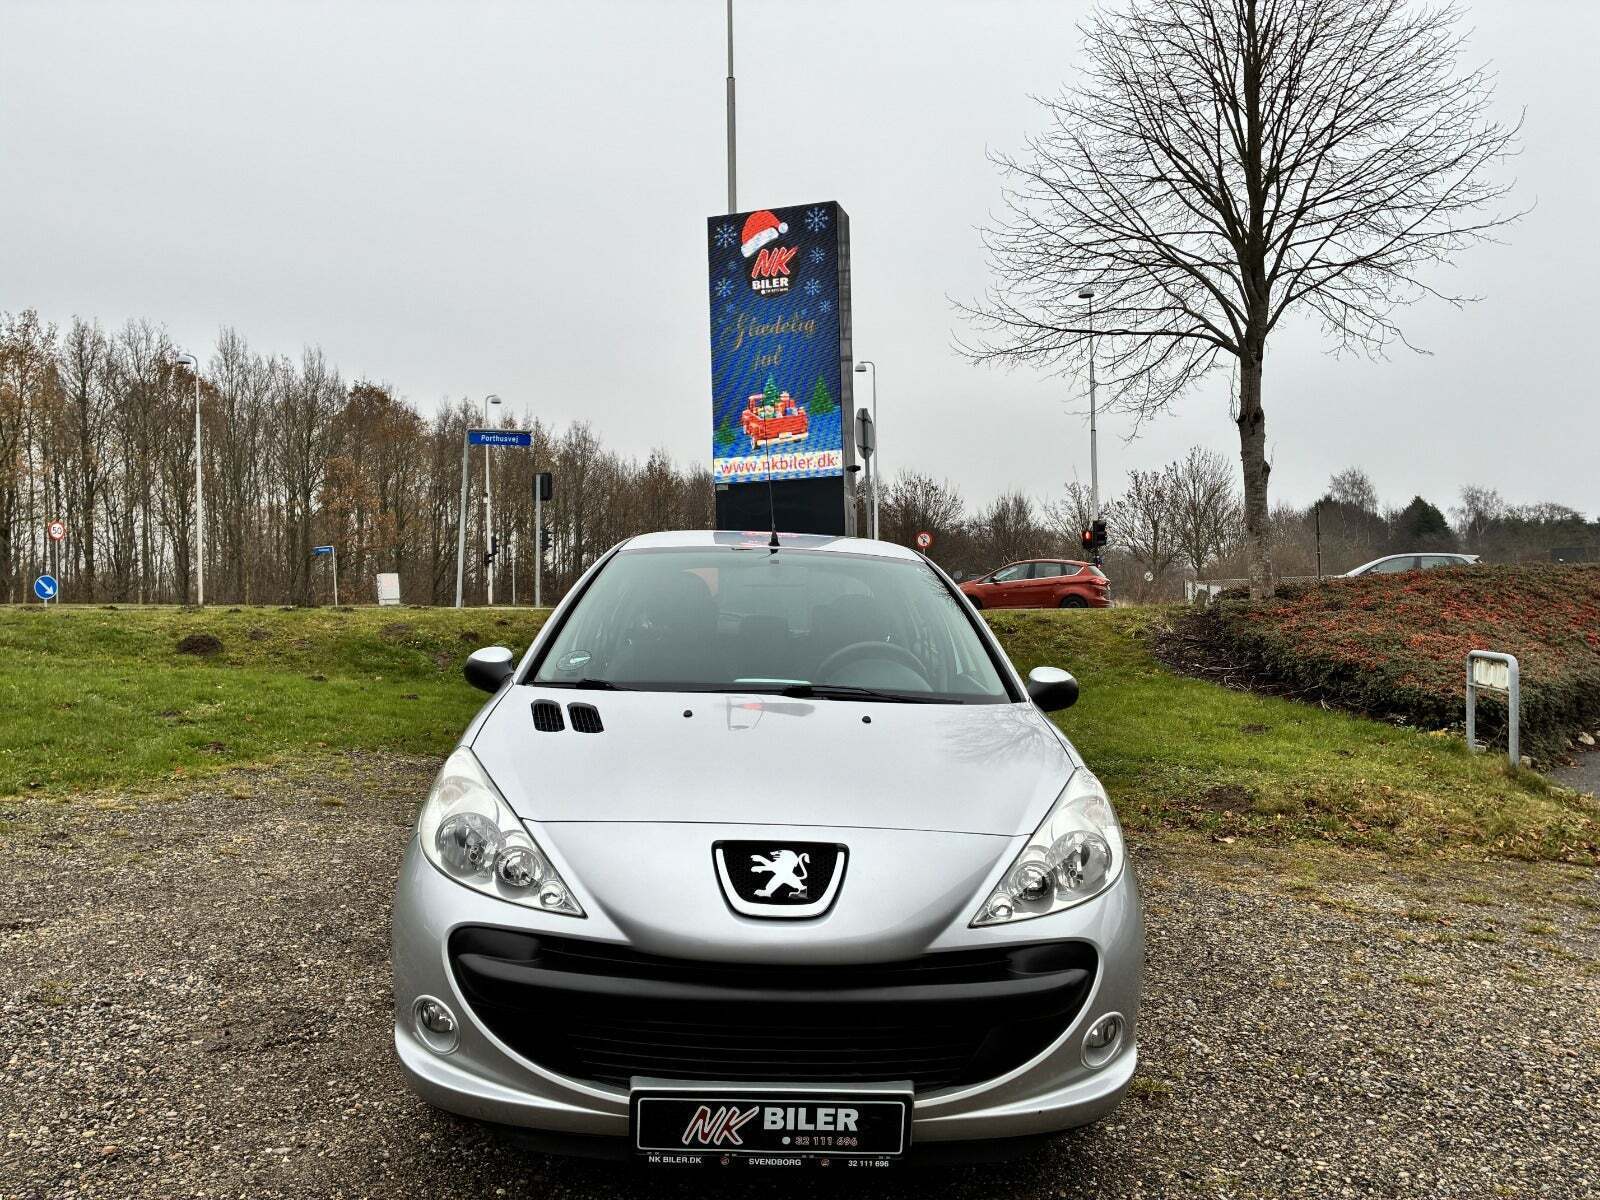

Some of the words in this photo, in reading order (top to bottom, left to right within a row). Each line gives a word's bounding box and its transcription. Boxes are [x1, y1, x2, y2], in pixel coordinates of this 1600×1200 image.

[751, 245, 798, 278] NK
[752, 278, 788, 290] BILER
[480, 434, 519, 444] Porthusvej
[721, 452, 837, 474] www.nkbiler.dk
[52, 526, 62, 535] 50
[681, 1105, 760, 1145] NK
[763, 1107, 859, 1132] BILER
[795, 1136, 810, 1146] 32
[813, 1136, 832, 1146] 111
[836, 1136, 858, 1146] 696
[662, 1156, 702, 1164] BILER.DK
[748, 1158, 802, 1166] SVENDBORG
